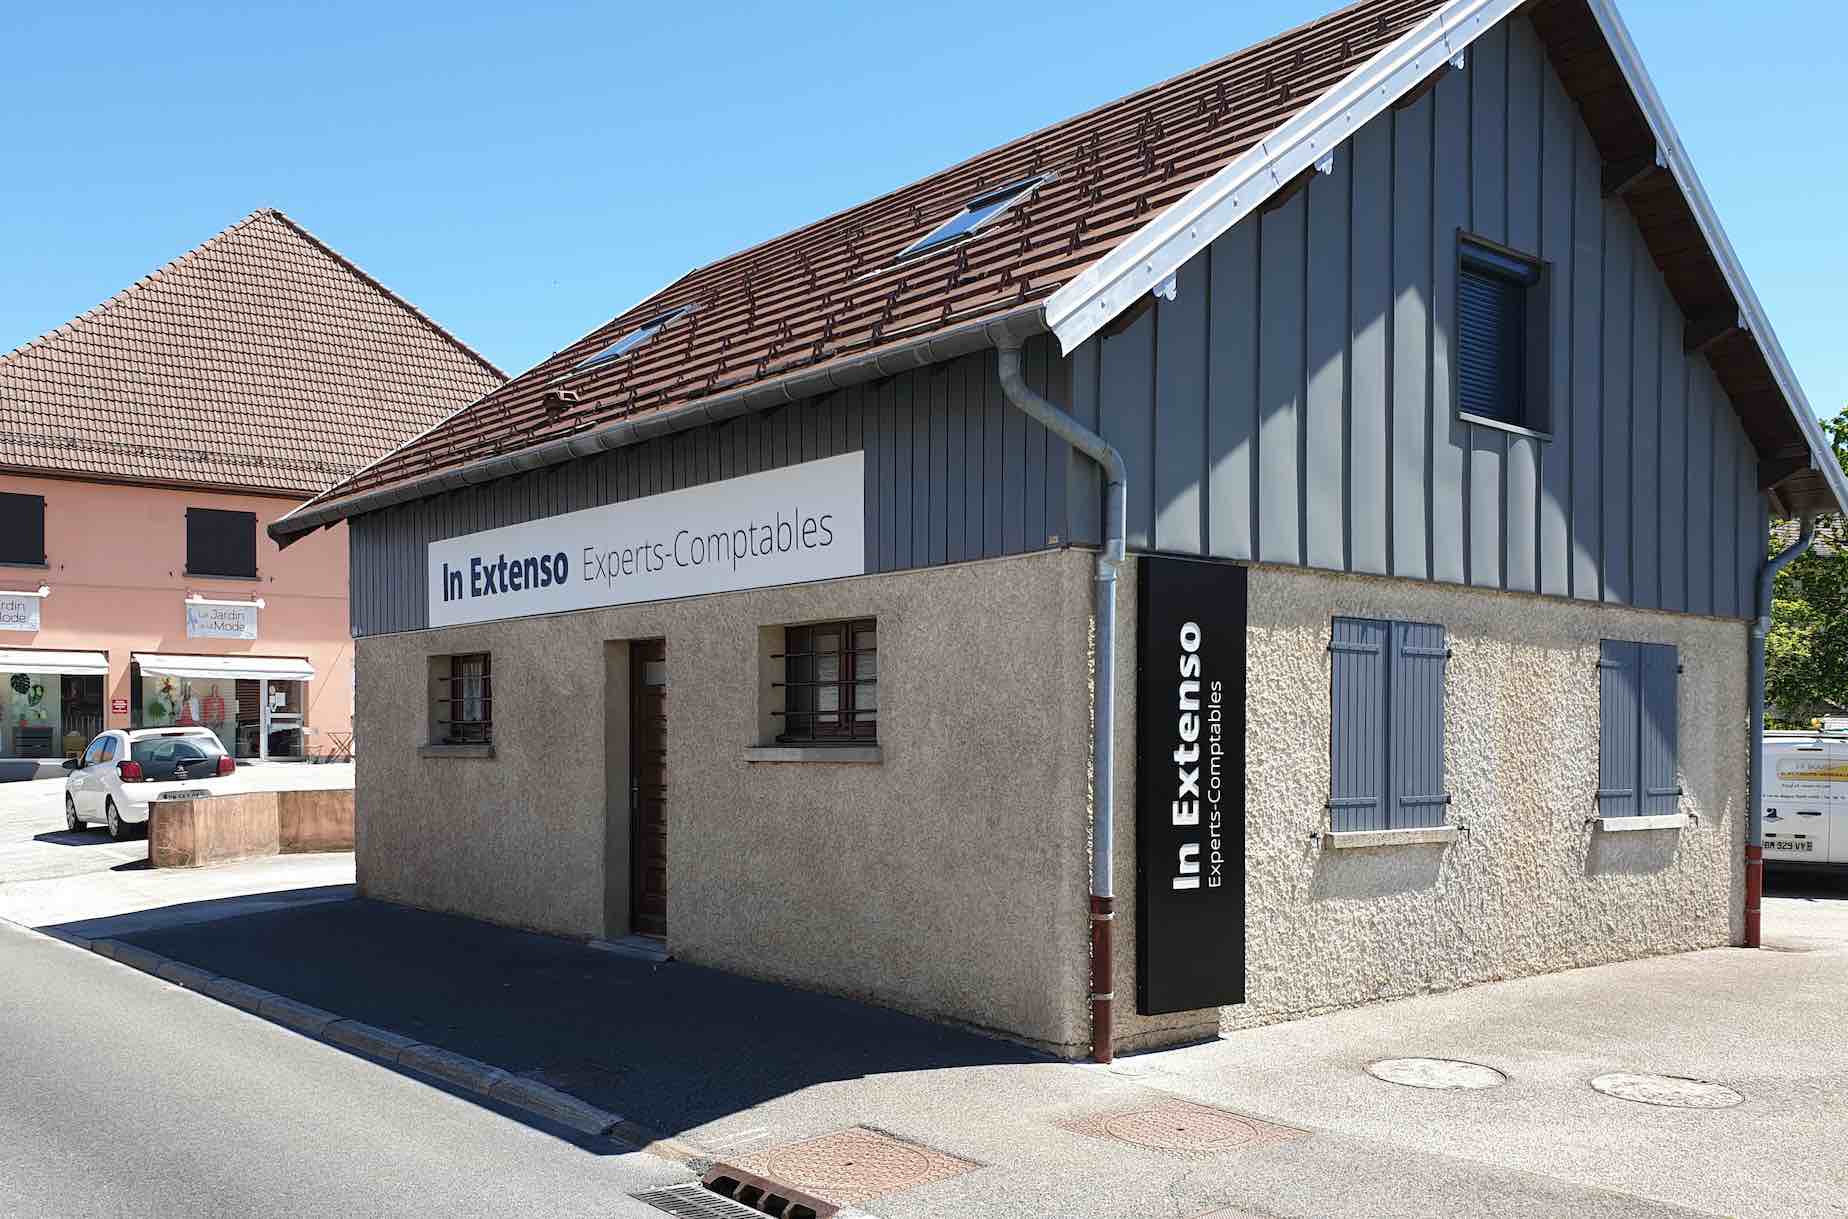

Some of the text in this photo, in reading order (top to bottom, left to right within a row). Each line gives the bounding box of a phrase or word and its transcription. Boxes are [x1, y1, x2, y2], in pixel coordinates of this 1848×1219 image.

[214, 621, 246, 632] Mode
[442, 507, 833, 602] In Extenso Experts-Comptables
[1171, 621, 1202, 890] In Extenso
[1207, 680, 1225, 889] Experts-Comptables
